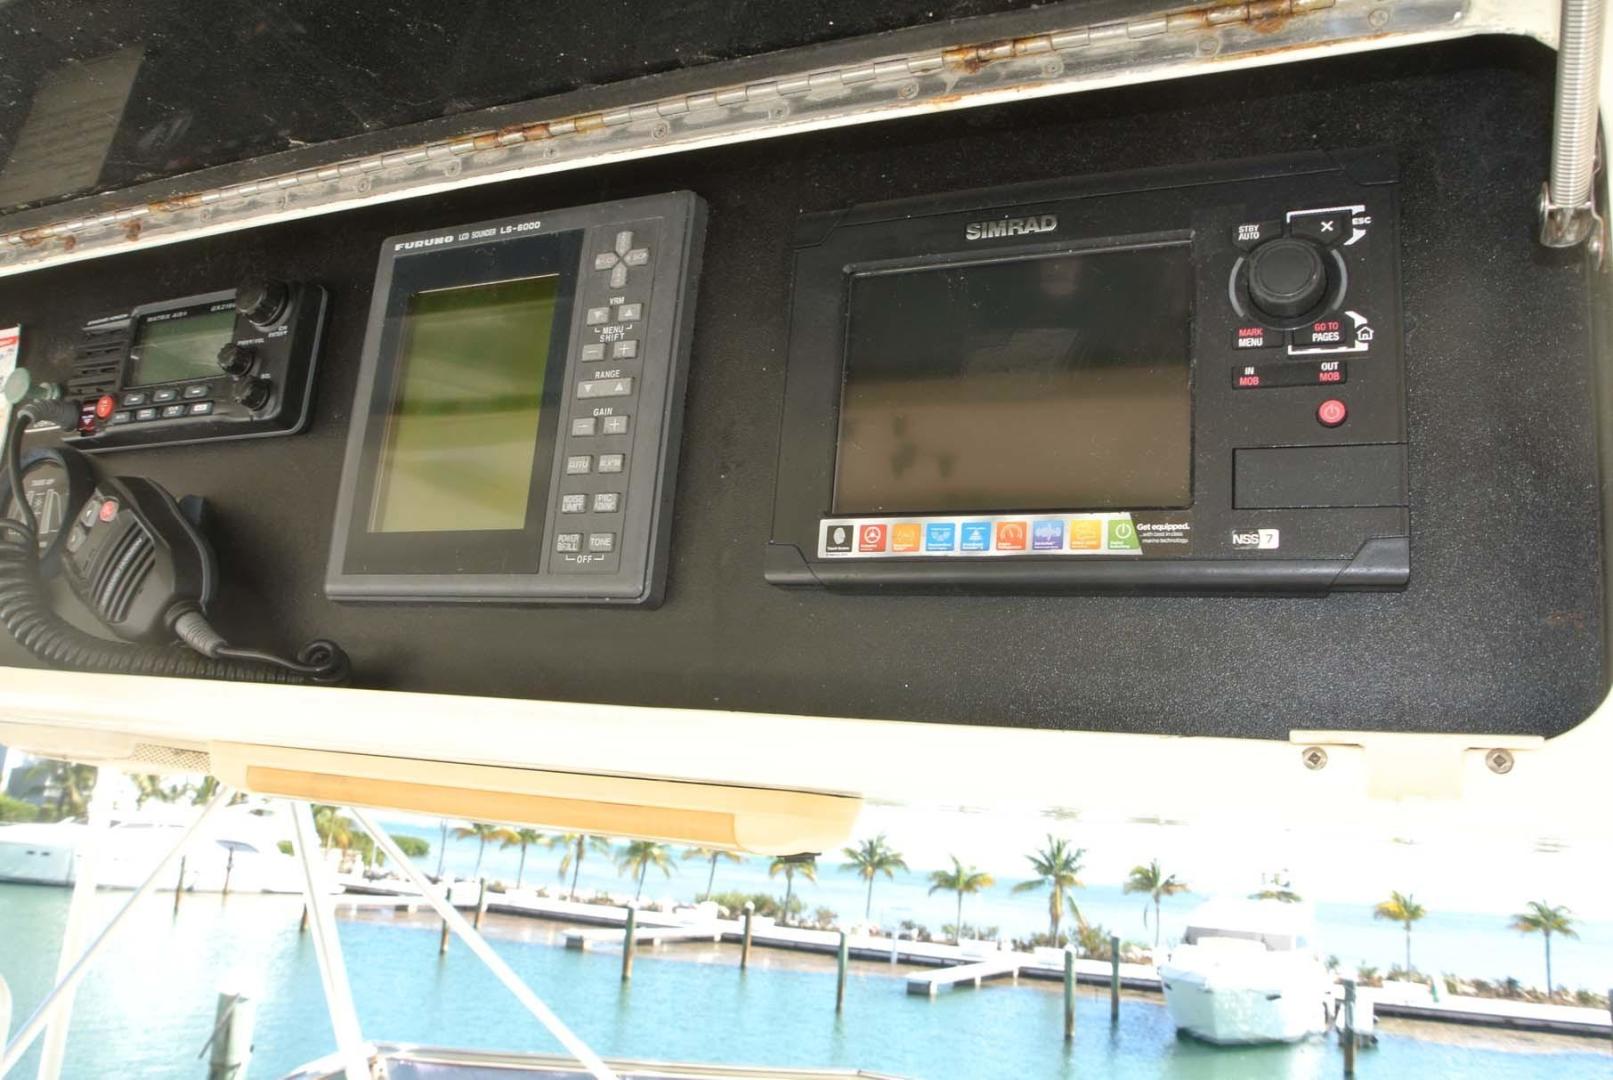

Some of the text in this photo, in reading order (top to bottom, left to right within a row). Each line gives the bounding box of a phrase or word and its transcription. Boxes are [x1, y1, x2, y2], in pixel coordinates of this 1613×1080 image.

[1352, 216, 1372, 225] ESC
[966, 215, 1057, 240] SIMRAD
[1238, 225, 1259, 233] STBY
[1238, 232, 1259, 240] AUTO
[394, 235, 454, 251] FURUNO
[602, 325, 624, 334] MENU
[1314, 322, 1338, 331] GO TO
[1239, 328, 1263, 337] MARK
[1312, 332, 1339, 342] PAGES
[600, 333, 624, 342] SHIFT
[1238, 338, 1263, 347] MENU
[1244, 366, 1254, 375] IN
[1321, 362, 1339, 371] OUT
[595, 370, 620, 378] RANGE
[1319, 372, 1340, 382] MOB
[1239, 376, 1259, 386] MOB
[593, 407, 613, 416] GAIN
[1136, 522, 1190, 531] Get equipped.
[590, 537, 611, 546] TONE
[1232, 534, 1259, 545] NSS
[576, 555, 592, 564] OFF
